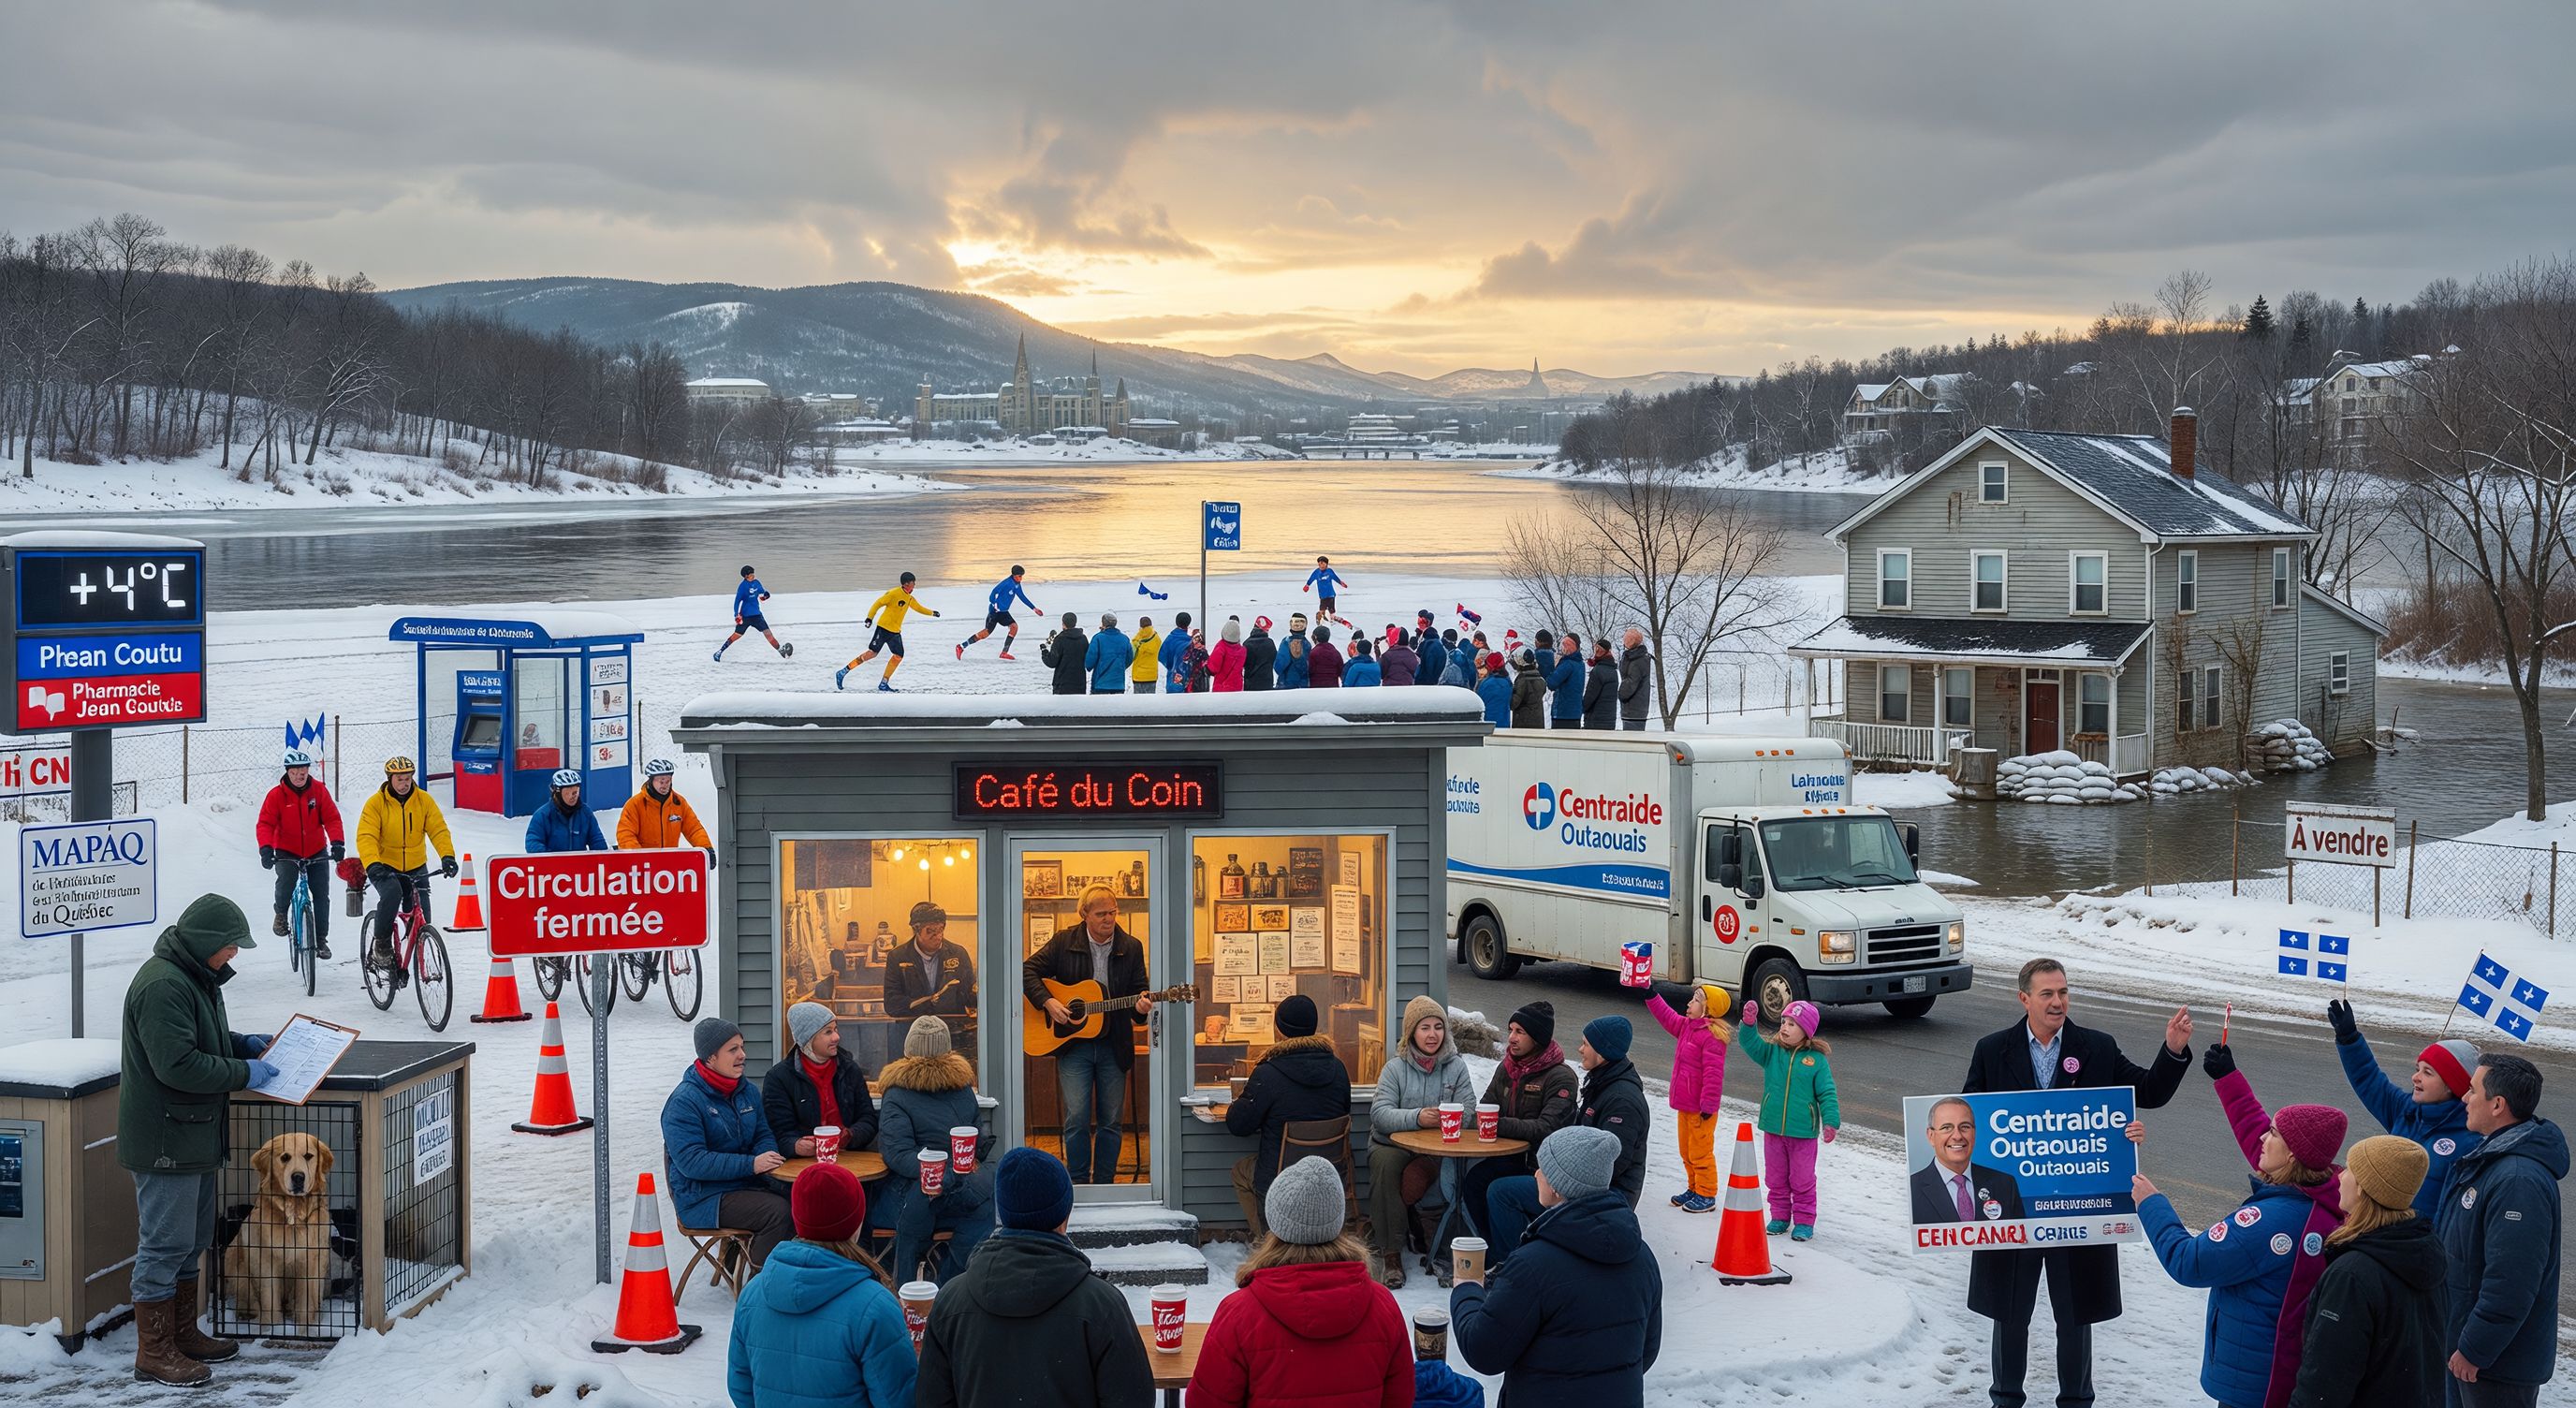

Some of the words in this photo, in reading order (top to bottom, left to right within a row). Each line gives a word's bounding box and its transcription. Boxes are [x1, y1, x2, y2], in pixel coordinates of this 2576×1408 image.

[70, 563, 186, 611] +4°C
[114, 642, 182, 666] Coutu
[72, 680, 161, 700] Pharmacie
[76, 700, 121, 718] Jean
[974, 772, 1059, 809] Café
[1071, 772, 1114, 808] du
[1128, 772, 1203, 807] Coin
[1559, 788, 1663, 826] Centraide
[32, 831, 148, 869] MAPAQ
[1560, 822, 1647, 854] Outaouais
[2312, 826, 2389, 858] vendre
[498, 862, 698, 901] Circulation
[534, 902, 664, 939] fermée
[1989, 1105, 2127, 1135] Centraide
[1990, 1133, 2108, 1159] Outaouais
[2019, 1158, 2110, 1178] Outaouais
